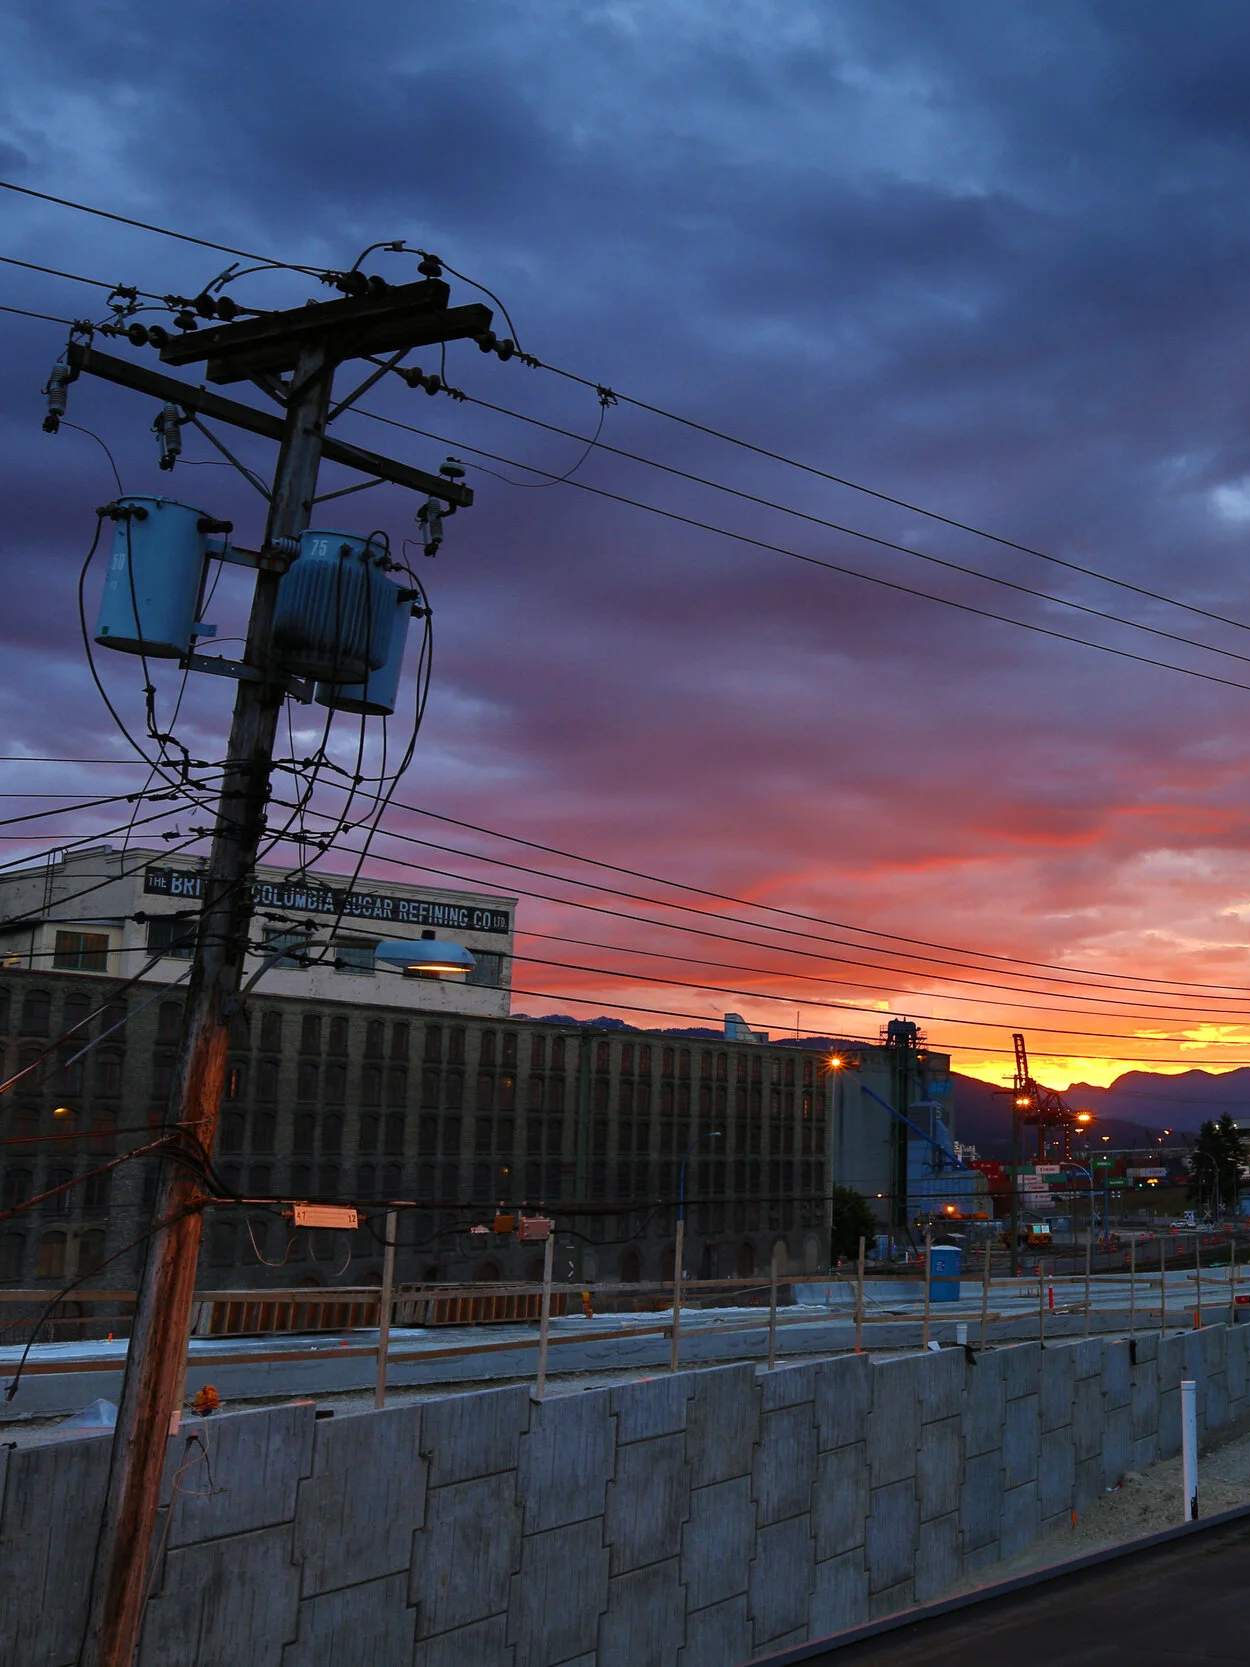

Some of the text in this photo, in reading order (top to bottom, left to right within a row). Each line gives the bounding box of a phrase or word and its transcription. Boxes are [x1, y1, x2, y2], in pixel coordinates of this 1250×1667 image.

[311, 539, 328, 556] 75
[149, 874, 167, 888] THE
[251, 884, 335, 912] COLUMBIA
[399, 900, 468, 927] REFINING
[474, 911, 491, 929] CO
[348, 1214, 356, 1223] 12
